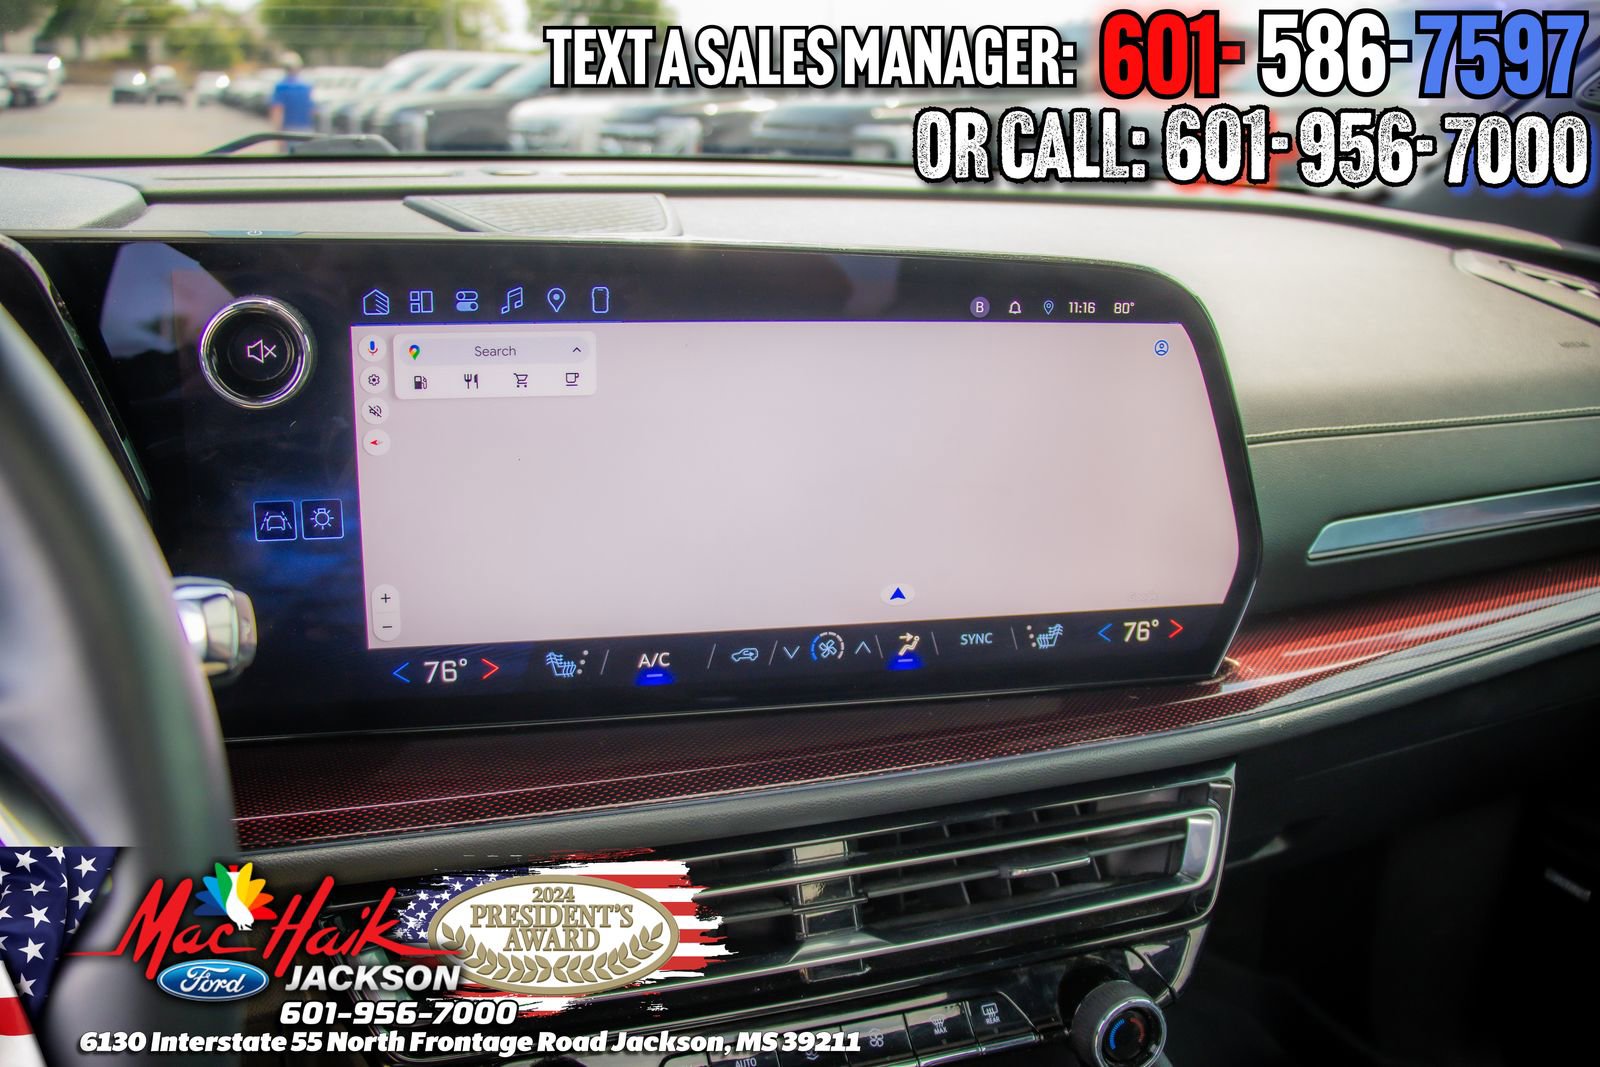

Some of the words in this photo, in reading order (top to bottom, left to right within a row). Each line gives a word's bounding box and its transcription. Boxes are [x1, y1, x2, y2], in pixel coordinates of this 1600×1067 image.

[1068, 301, 1096, 314] 11:16
[1113, 301, 1135, 314] 80°
[474, 345, 517, 358] Search
[1123, 619, 1159, 643] 76°
[960, 632, 993, 646] SYNC
[637, 652, 670, 668] A/C
[423, 658, 468, 684] 76°
[985, 1016, 1000, 1025] REAR
[933, 1026, 948, 1035] MAX
[735, 1057, 757, 1067] AUTO
